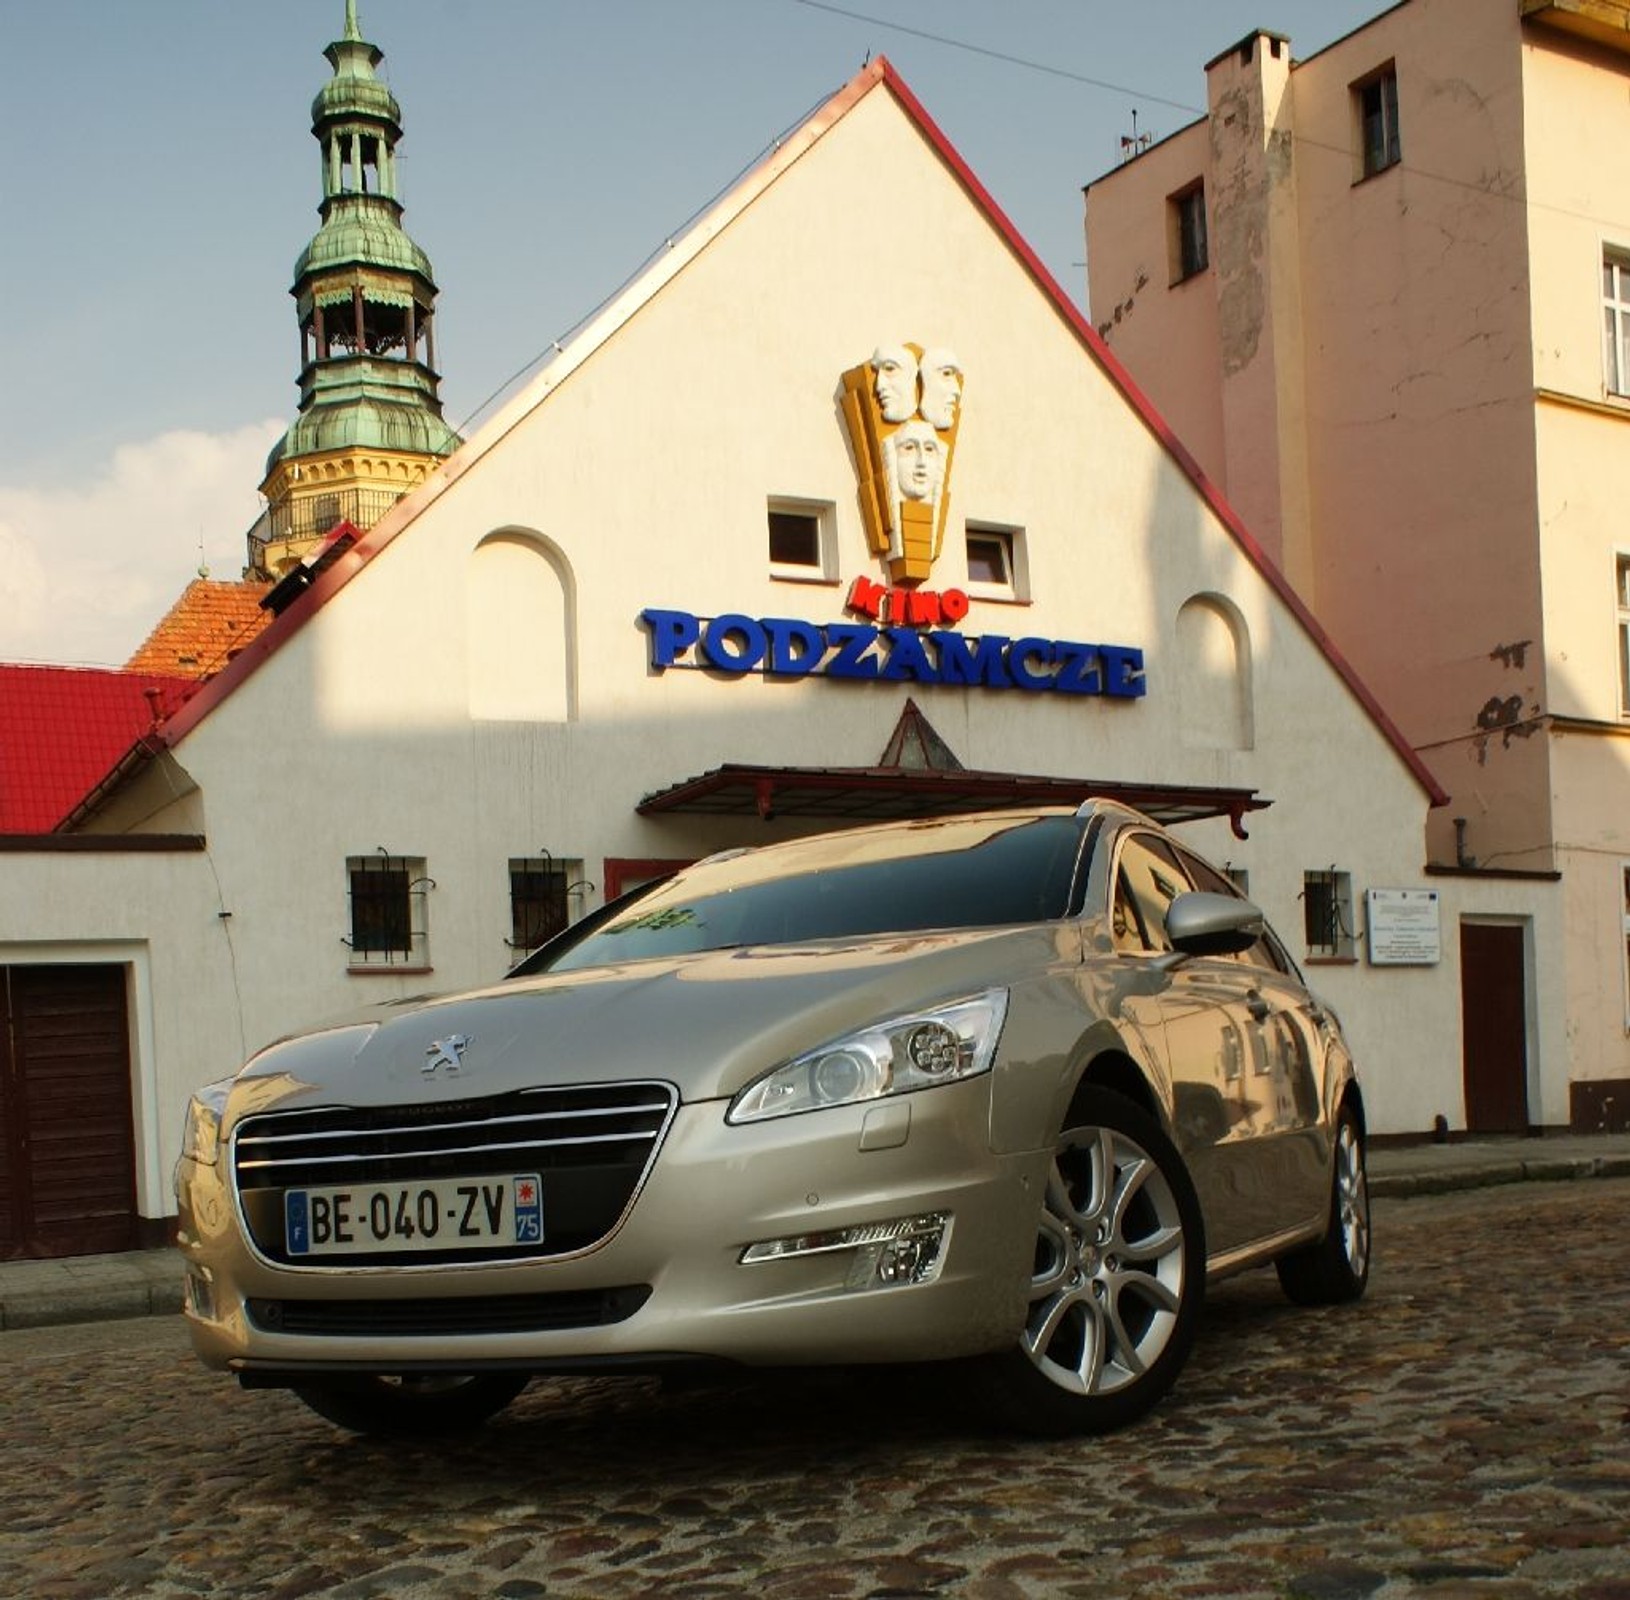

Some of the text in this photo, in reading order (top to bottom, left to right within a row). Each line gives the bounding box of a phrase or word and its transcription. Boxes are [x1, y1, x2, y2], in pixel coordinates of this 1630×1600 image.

[847, 575, 969, 624] KINO
[643, 609, 1146, 698] PODZAMCZE
[311, 1186, 504, 1243] BE-040-ZV
[517, 1214, 539, 1239] 75
